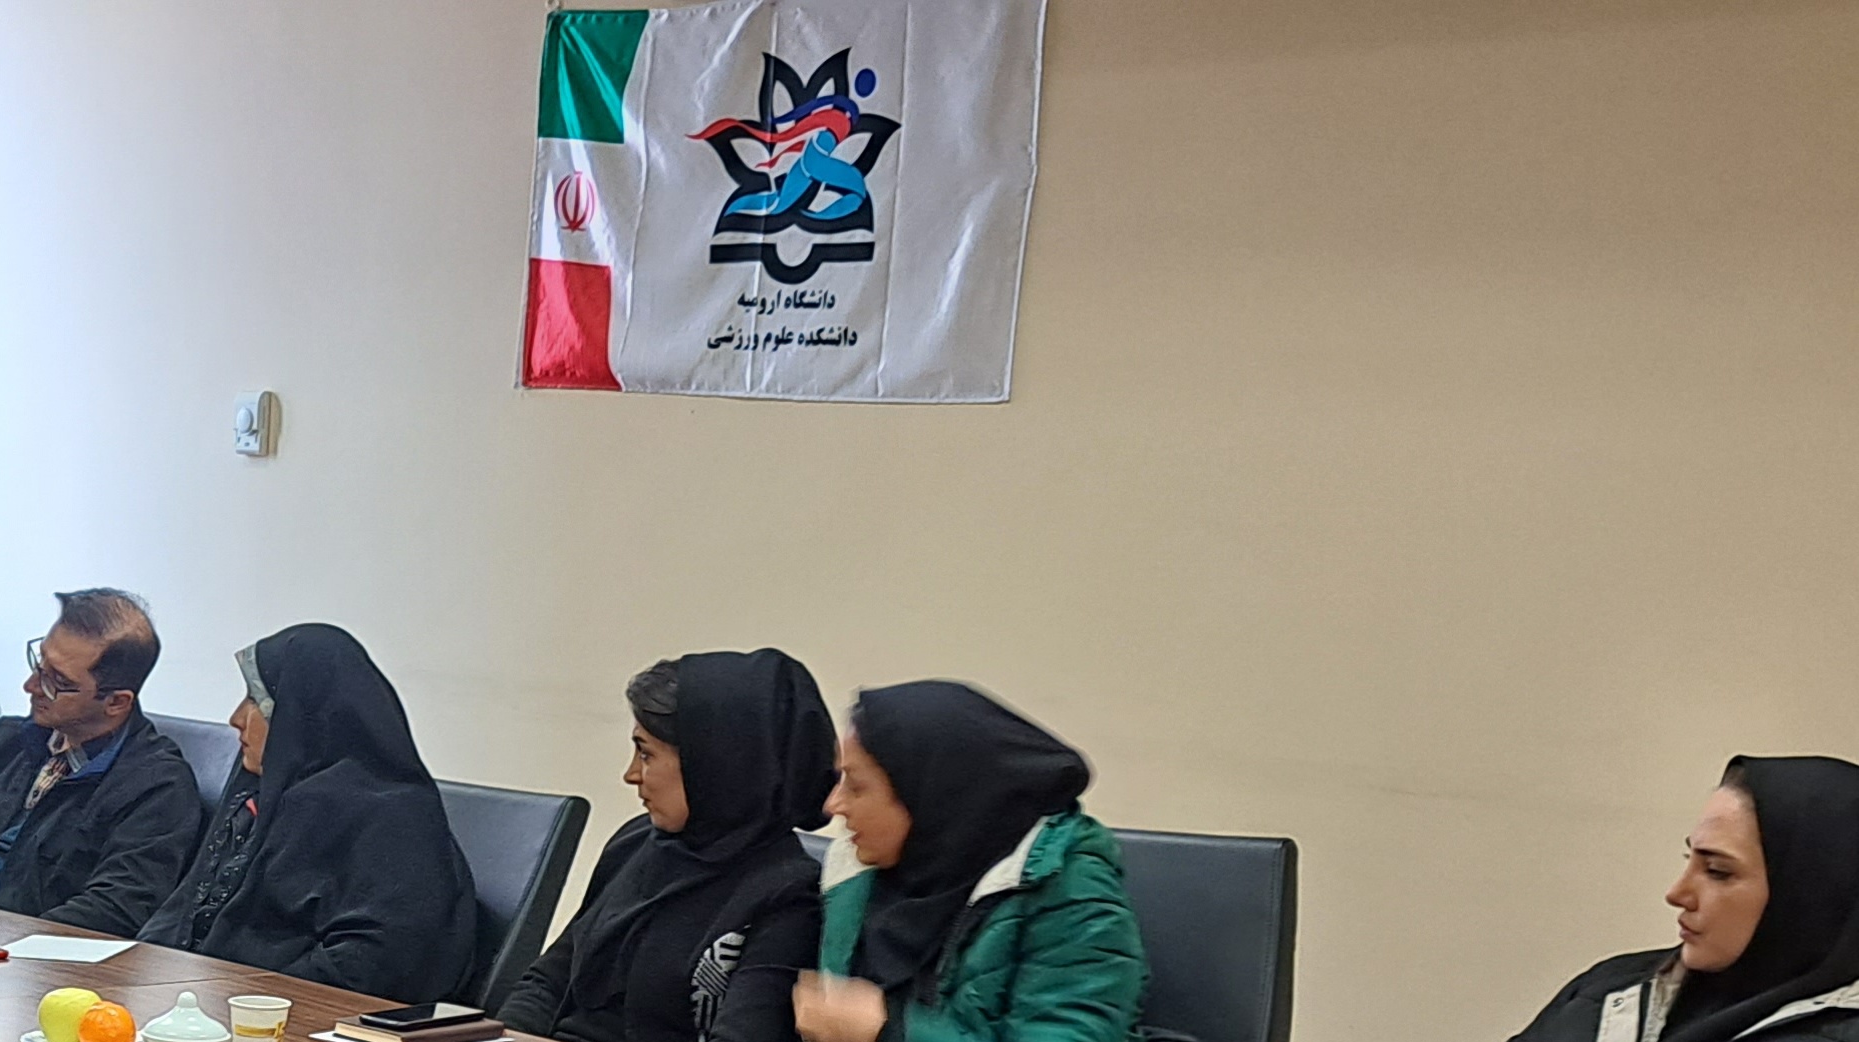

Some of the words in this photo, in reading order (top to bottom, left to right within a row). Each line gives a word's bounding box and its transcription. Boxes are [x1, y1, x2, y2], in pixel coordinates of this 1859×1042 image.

[784, 288, 836, 309] دانشگاه
[707, 324, 759, 350] ورزشی
[762, 325, 794, 352] علوم
[797, 325, 858, 347] دانشکده
